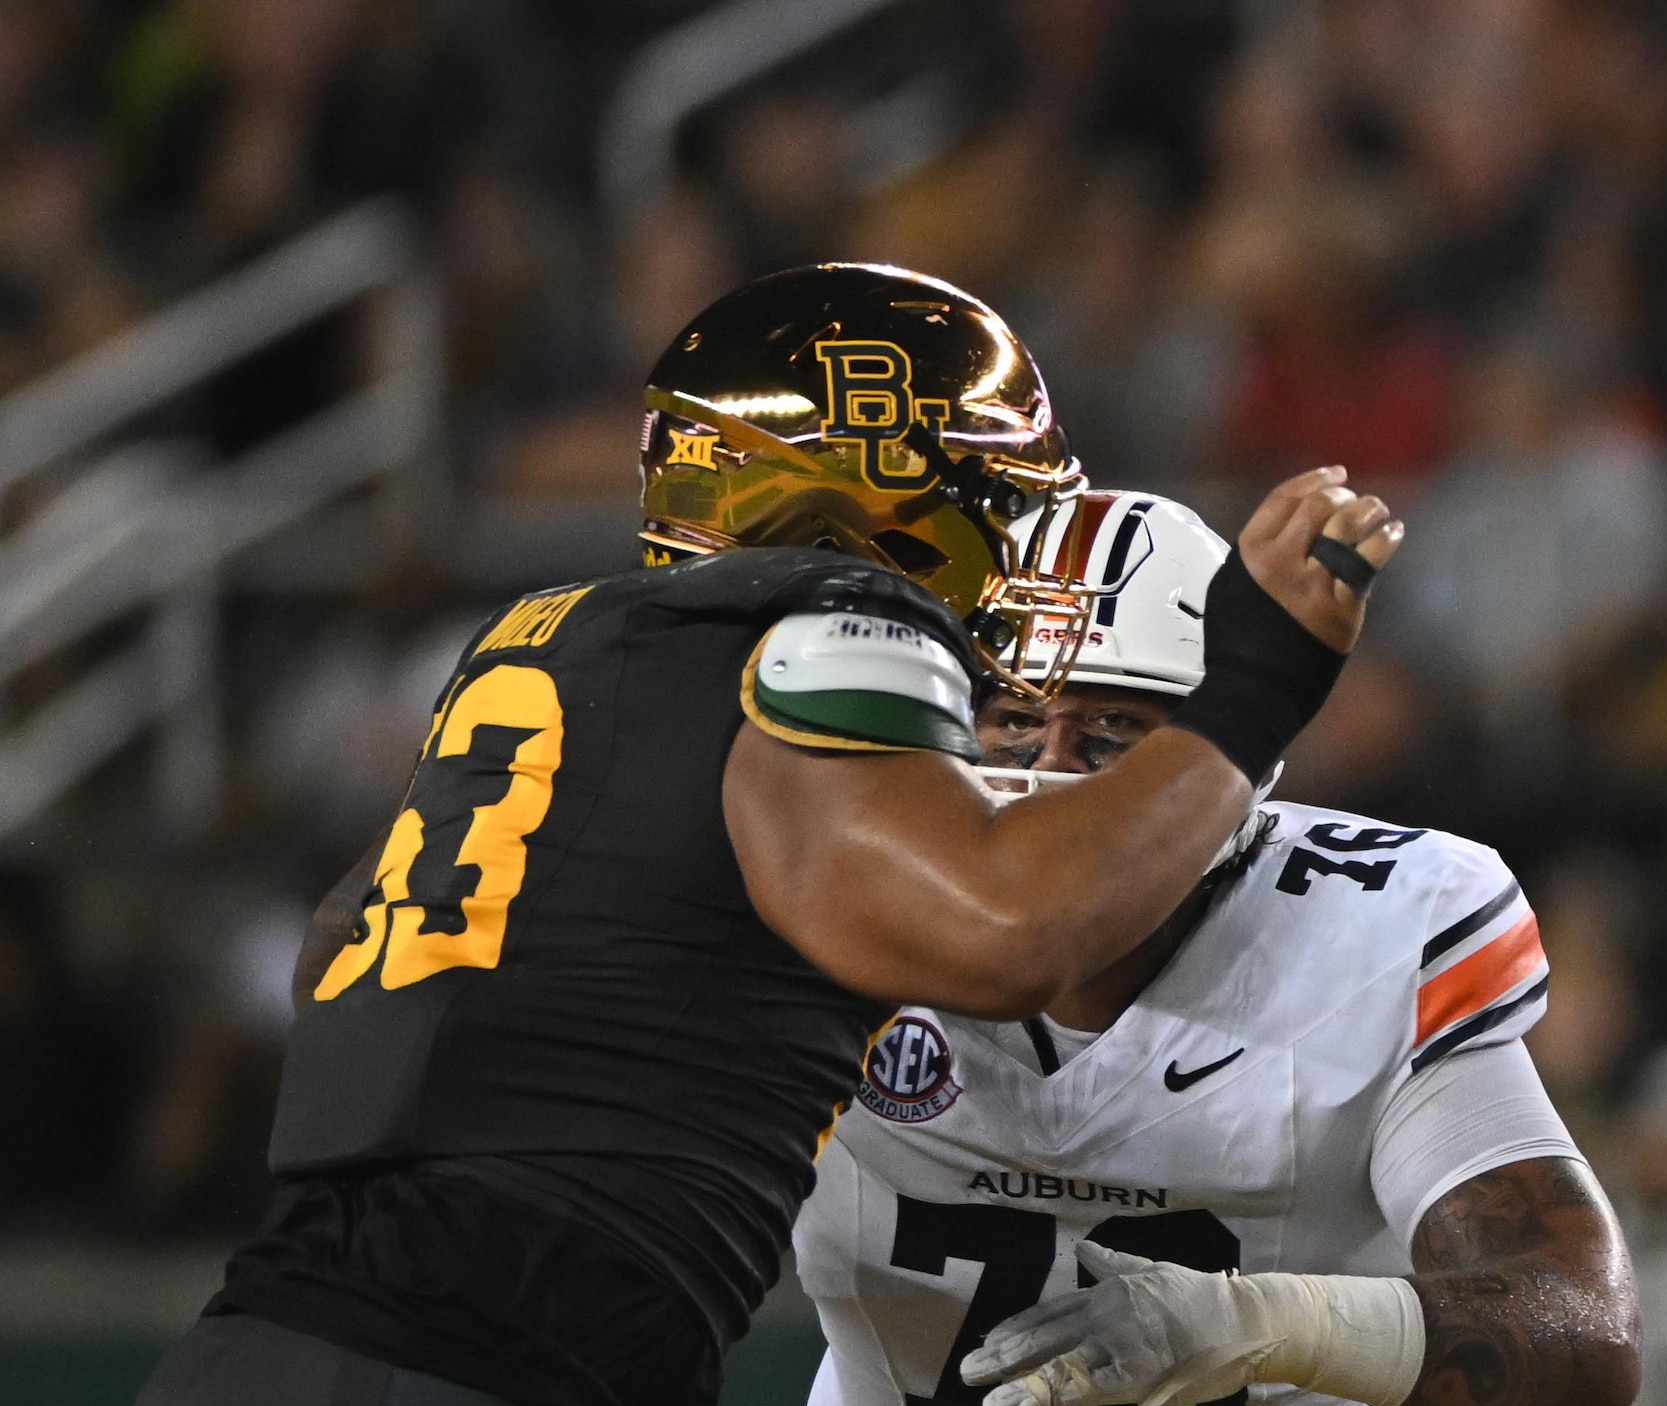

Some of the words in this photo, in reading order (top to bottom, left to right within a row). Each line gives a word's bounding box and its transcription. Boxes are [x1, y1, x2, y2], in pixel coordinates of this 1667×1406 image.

[666, 429, 721, 471] XII
[1275, 823, 1429, 896] 76
[873, 1023, 940, 1095] SEC
[859, 1081, 944, 1119] GRADUATE
[968, 1171, 1167, 1208] AUBURN
